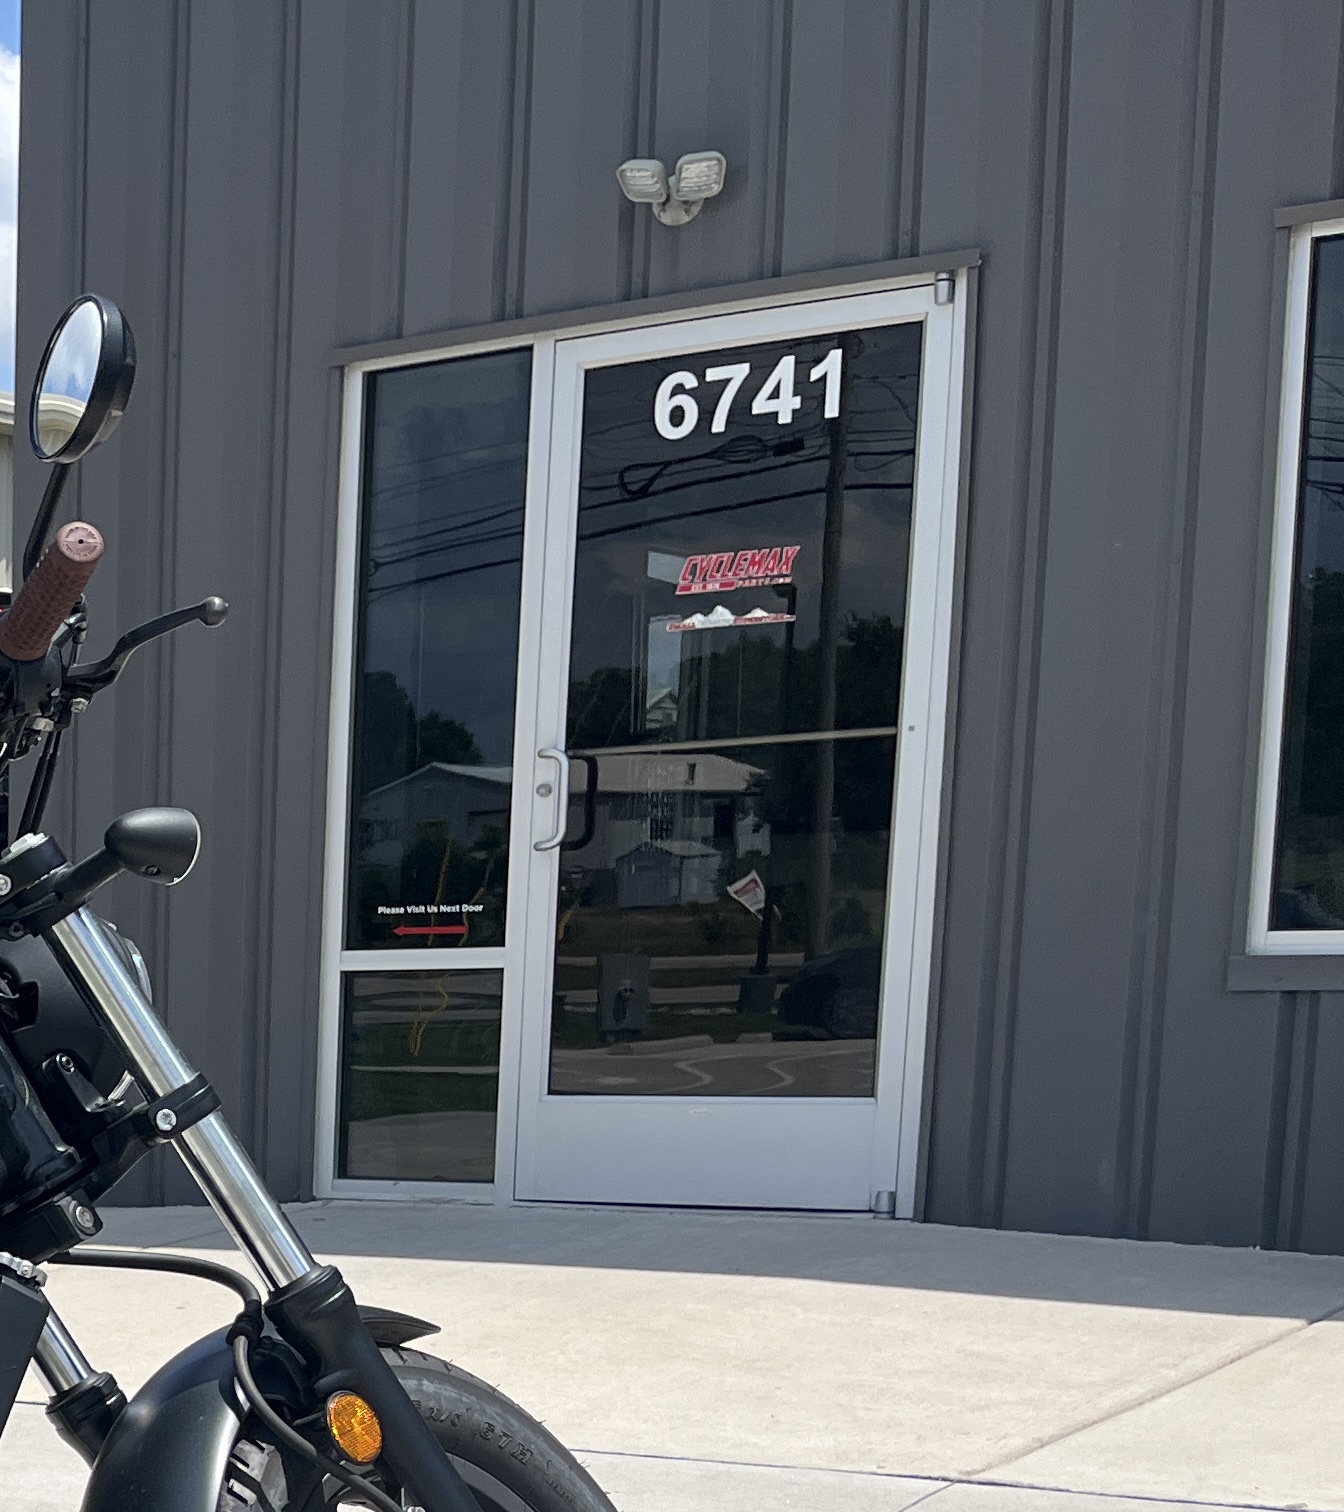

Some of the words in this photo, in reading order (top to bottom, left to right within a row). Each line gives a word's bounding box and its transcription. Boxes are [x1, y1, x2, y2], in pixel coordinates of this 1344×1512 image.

[654, 348, 843, 440] 6741
[678, 545, 801, 583] CYCLEMAX
[377, 906, 405, 914] Please
[406, 905, 425, 914] Visit
[426, 904, 438, 913] Us
[439, 904, 460, 913] Next
[461, 904, 483, 912] Door
